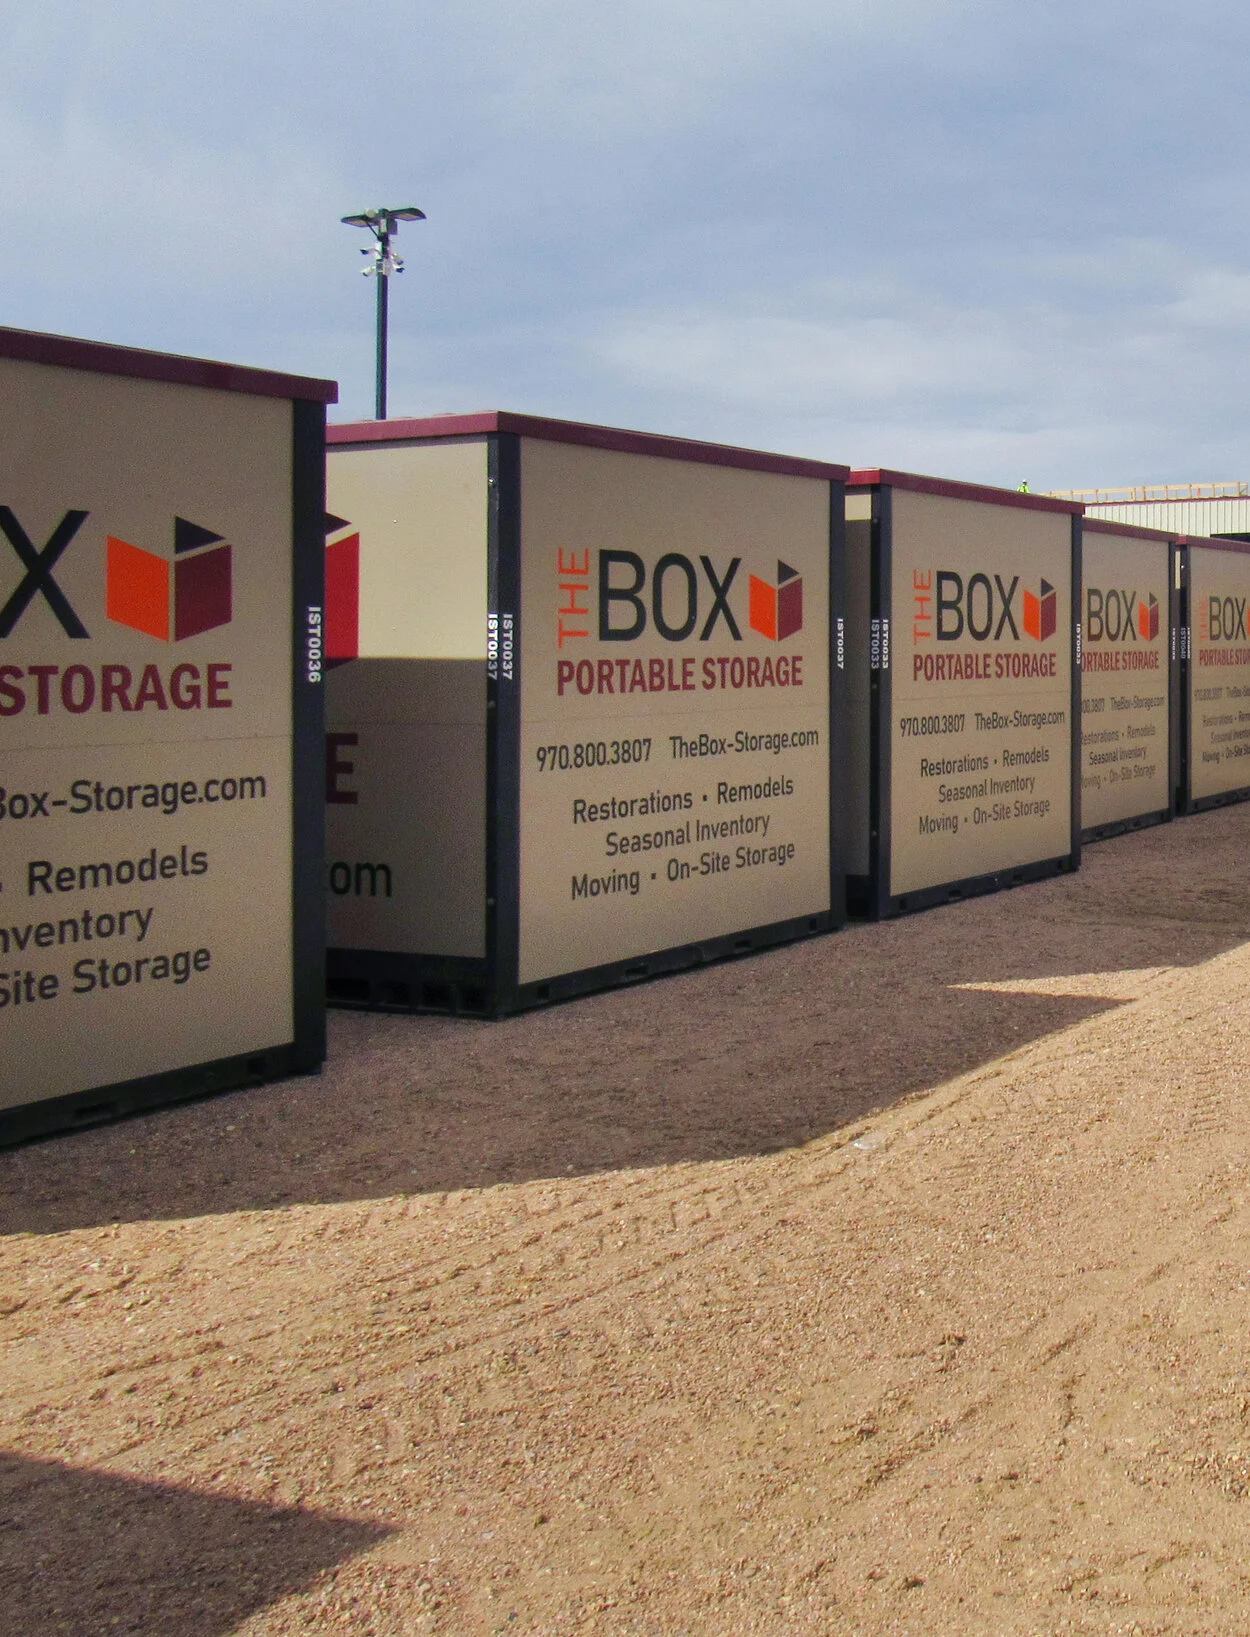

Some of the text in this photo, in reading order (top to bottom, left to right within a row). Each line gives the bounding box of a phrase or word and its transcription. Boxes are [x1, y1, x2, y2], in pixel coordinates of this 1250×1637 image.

[558, 547, 743, 648] THE BOX
[913, 569, 932, 646] THE
[936, 570, 1020, 641] BOX
[1087, 588, 1137, 642] BOX
[1209, 596, 1246, 641] BOX
[308, 607, 321, 683] IST0036
[488, 614, 498, 680] IST0037
[503, 614, 513, 680] IST0037
[913, 653, 1057, 681] PORTABLE STORAGE
[1081, 650, 1160, 672] ORTABLE STORAGE
[1199, 648, 1234, 667] PORTABLE
[0, 663, 232, 716] STORAGE
[557, 655, 804, 696] PORTABLE STORAGE
[900, 710, 1065, 737] 970.800.3807 TheBox-Storage.com
[536, 728, 819, 772] 970.800.3807 TheBox-Storage.com
[920, 746, 1050, 777] Restorations Remodels
[573, 775, 794, 824] Restorations Remodels
[938, 775, 1036, 803] Seasonal Inventory
[605, 814, 770, 857] Seasonal Inventory
[919, 799, 1051, 834] Moving On-Site Storage
[28, 846, 208, 895] Remodels
[571, 841, 795, 900] Moving On-Site Storage
[73, 948, 211, 993] Storage
